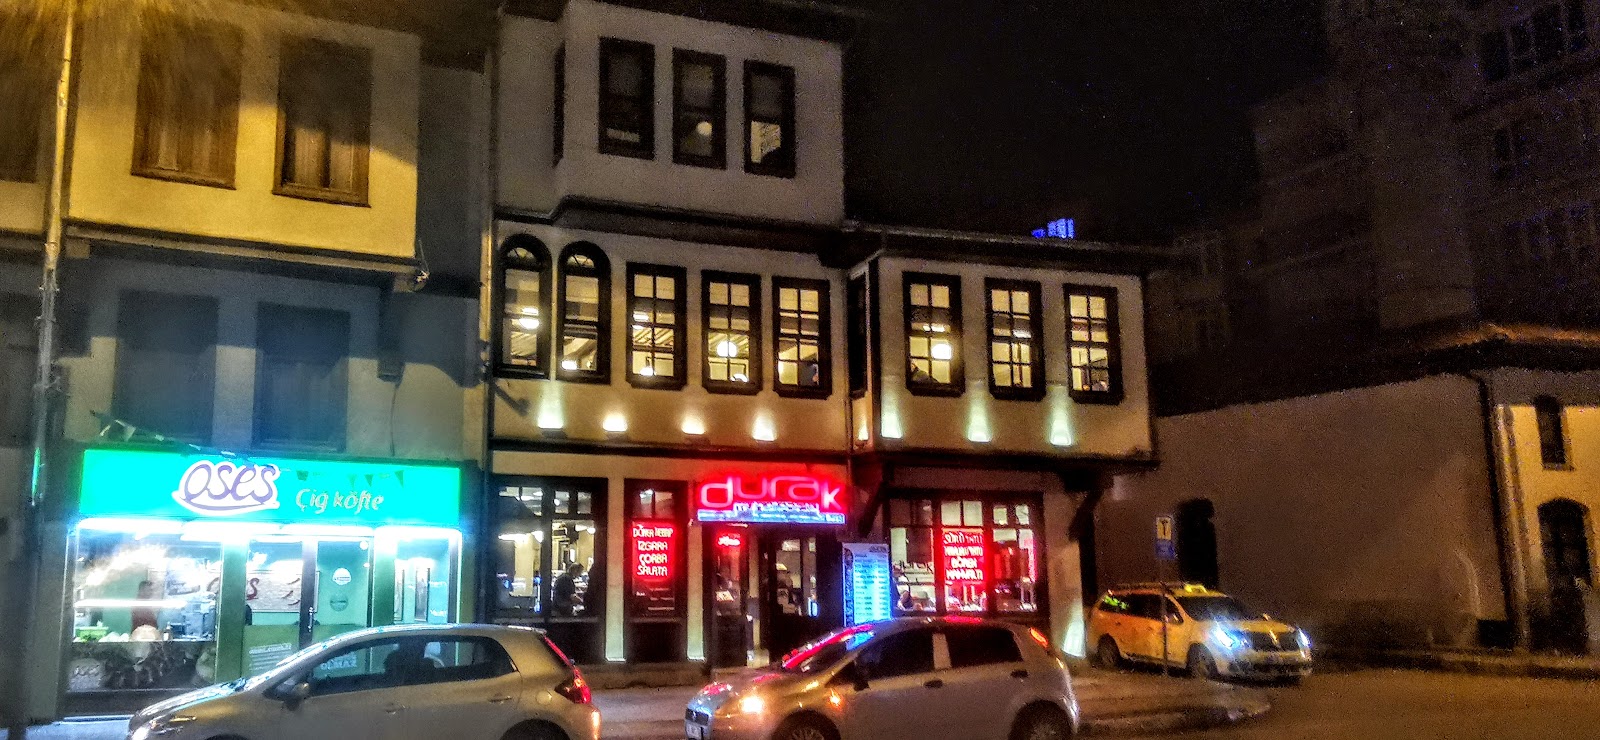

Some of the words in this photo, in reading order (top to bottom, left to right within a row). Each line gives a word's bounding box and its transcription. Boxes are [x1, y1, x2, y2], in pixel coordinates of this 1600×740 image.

[333, 490, 385, 515] köfte
[701, 476, 842, 510] durak
[639, 553, 668, 566] ÇORBA
[637, 565, 668, 576] SALATA
